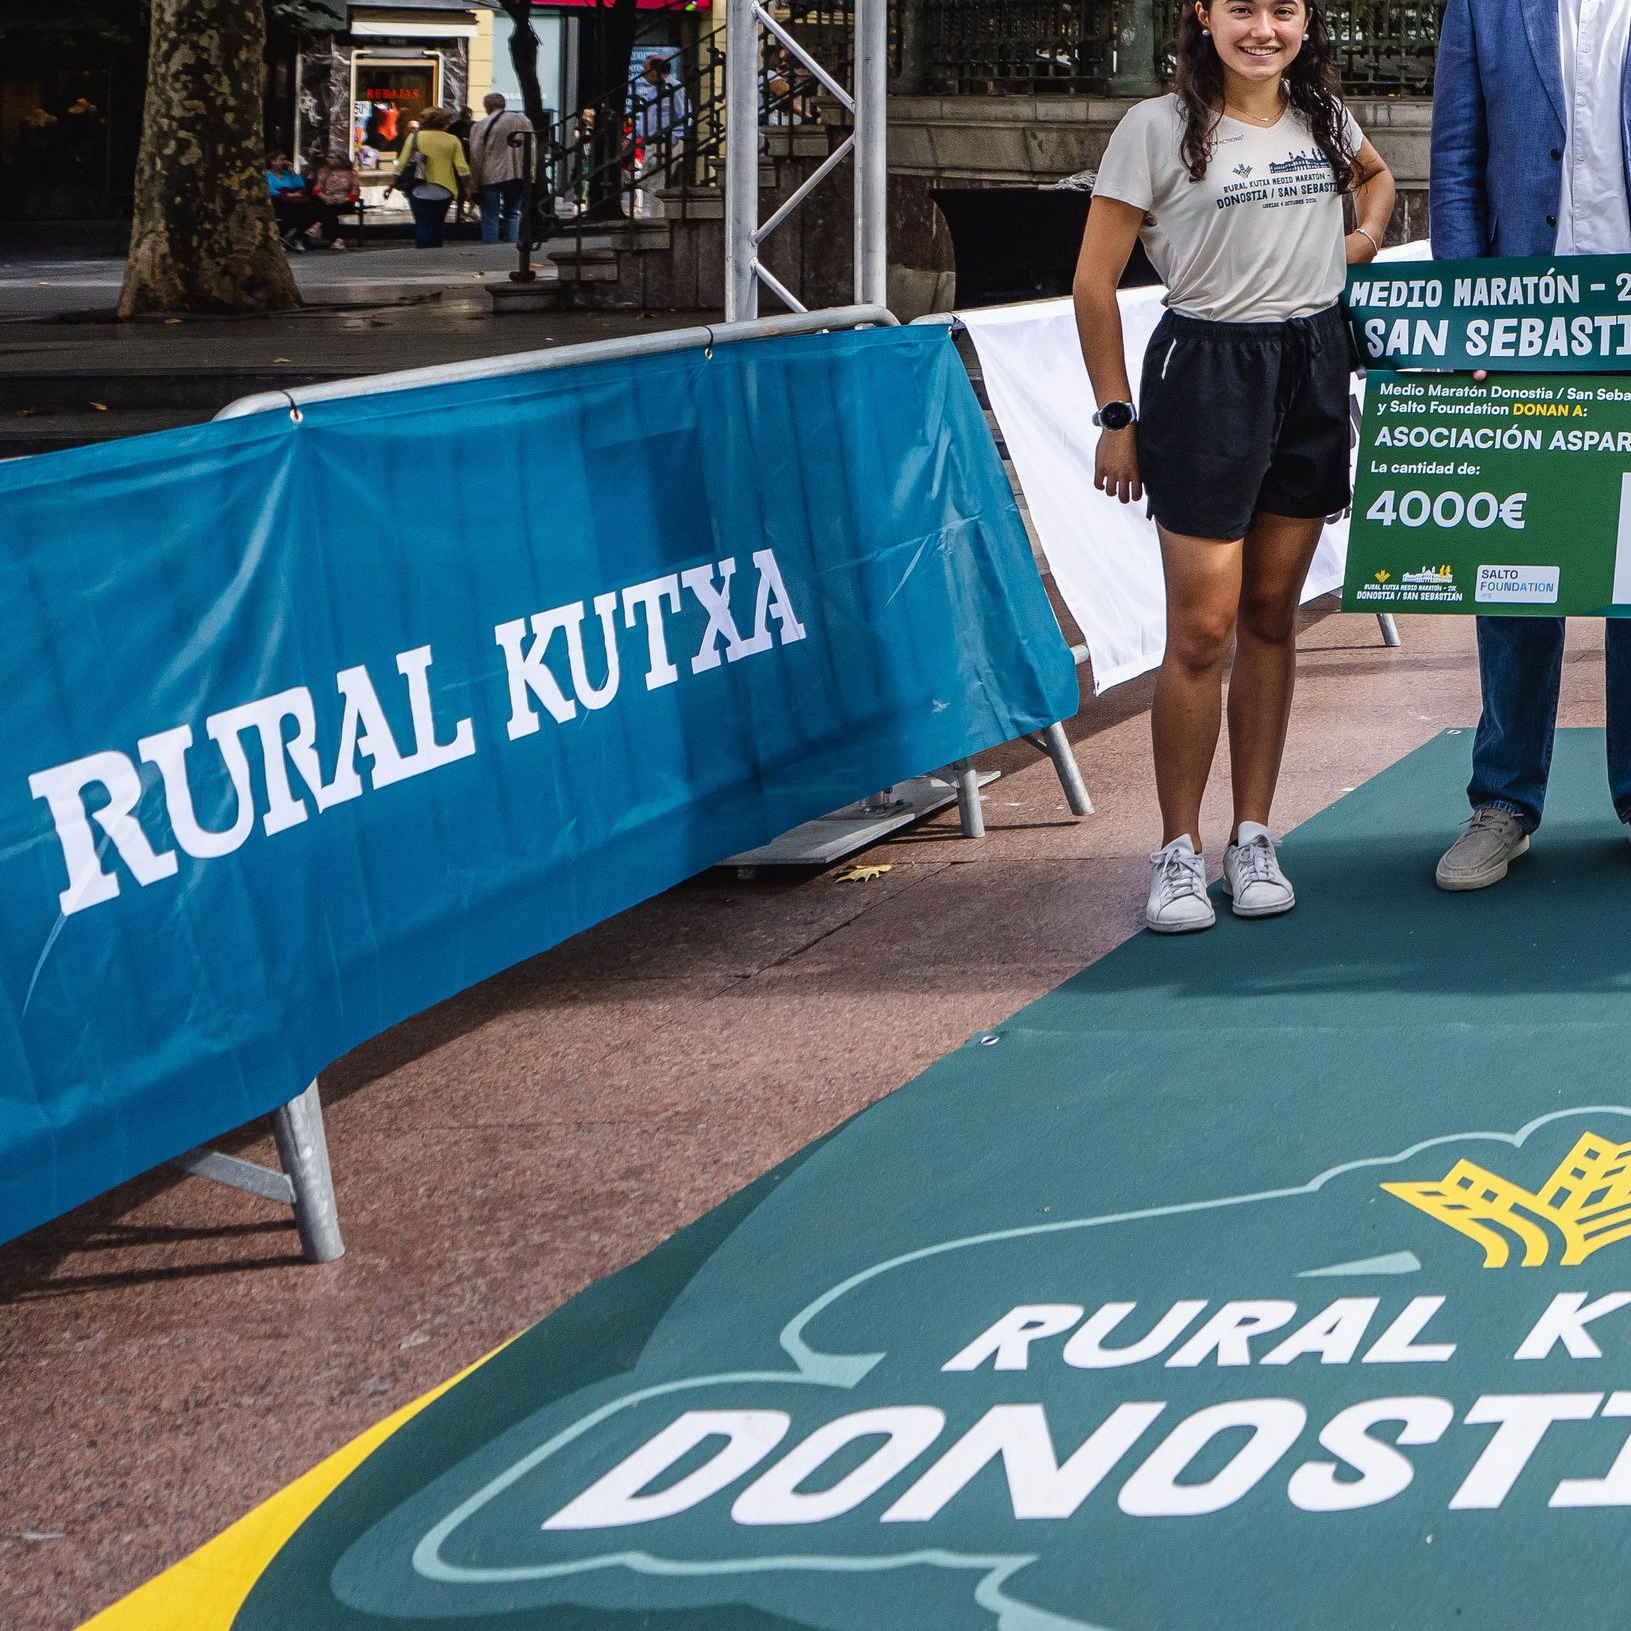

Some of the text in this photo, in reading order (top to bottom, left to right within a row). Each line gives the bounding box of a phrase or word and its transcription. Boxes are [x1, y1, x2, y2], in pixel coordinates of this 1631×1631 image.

[1223, 183, 1248, 194] RURAL
[1249, 178, 1271, 190] KUTXA
[1272, 176, 1294, 185] MEDIO
[1216, 188, 1268, 210] DONOSTIA
[1278, 185, 1298, 198] SAN
[1348, 278, 1443, 309] MEDIO
[1452, 267, 1581, 308] MARATÓN
[1364, 317, 1450, 358] SAN
[1380, 382, 1425, 397] Medio
[1428, 384, 1488, 399] Maratón
[1491, 385, 1554, 400] Donostia
[1556, 387, 1565, 401] /
[1566, 387, 1594, 401] San
[1376, 400, 1588, 418] y Salto Foundation DONAN A:
[1374, 424, 1543, 451] ASOCIACIÓN
[1370, 460, 1481, 477] La cantidad de:
[1365, 489, 1528, 531] 4000€
[1481, 569, 1519, 580] SALTO
[1356, 590, 1463, 602] DONOSTIA SAN SEBASTIÁN
[1363, 583, 1381, 591] RURAL
[1382, 583, 1400, 592] KUTXA
[1400, 583, 1417, 592] MEDIO
[1480, 581, 1555, 592] FOUNDATION
[27, 547, 807, 917] RURAL KUTXA
[941, 1294, 1457, 1373] RURAL
